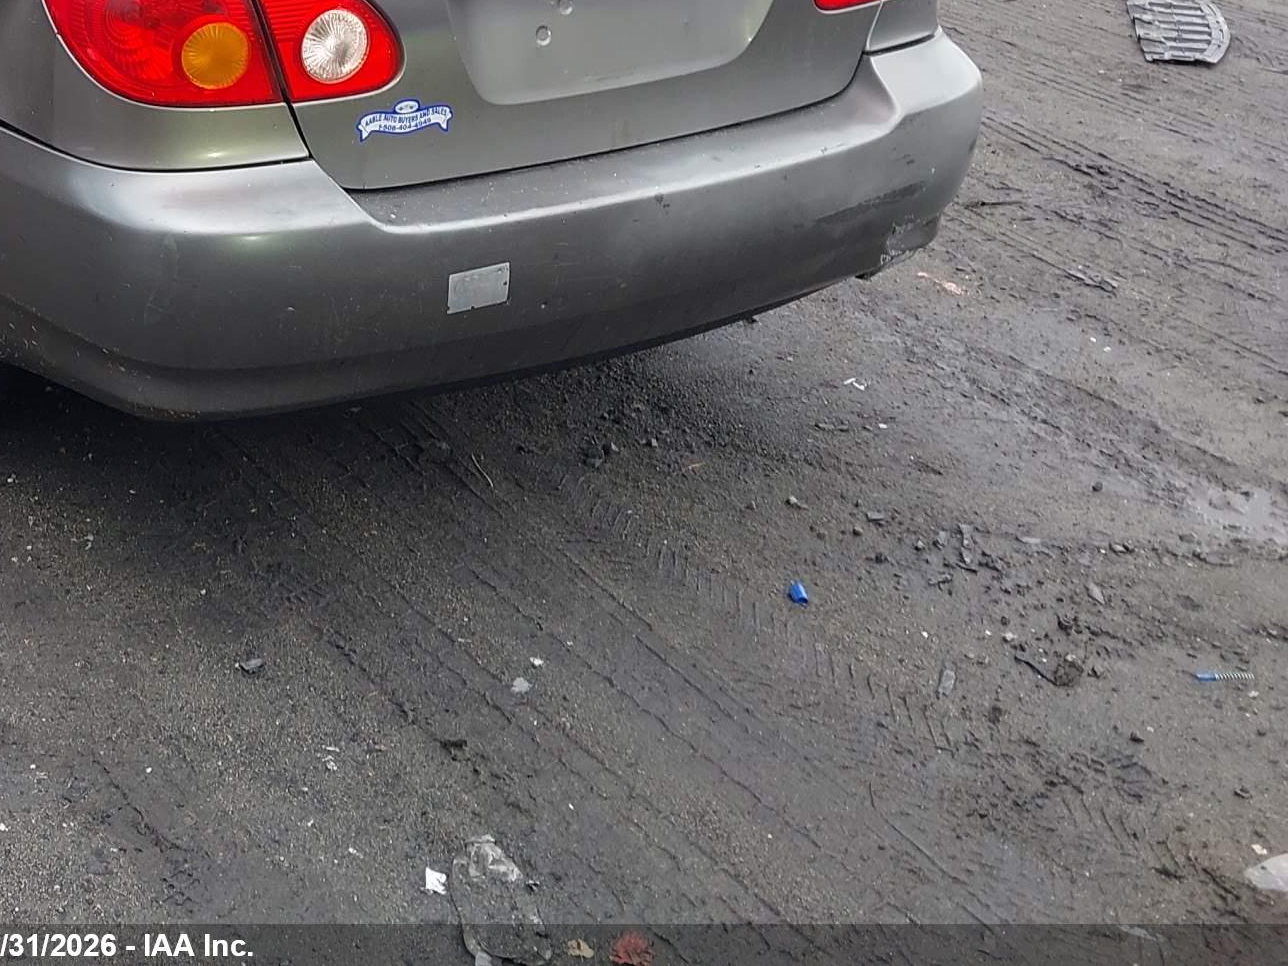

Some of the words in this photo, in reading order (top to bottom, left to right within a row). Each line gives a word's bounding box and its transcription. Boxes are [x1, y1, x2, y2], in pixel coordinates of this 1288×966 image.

[383, 114, 397, 123] AUTO
[398, 114, 419, 124] BUYERS
[419, 108, 431, 119] AND
[430, 106, 448, 116] SALES
